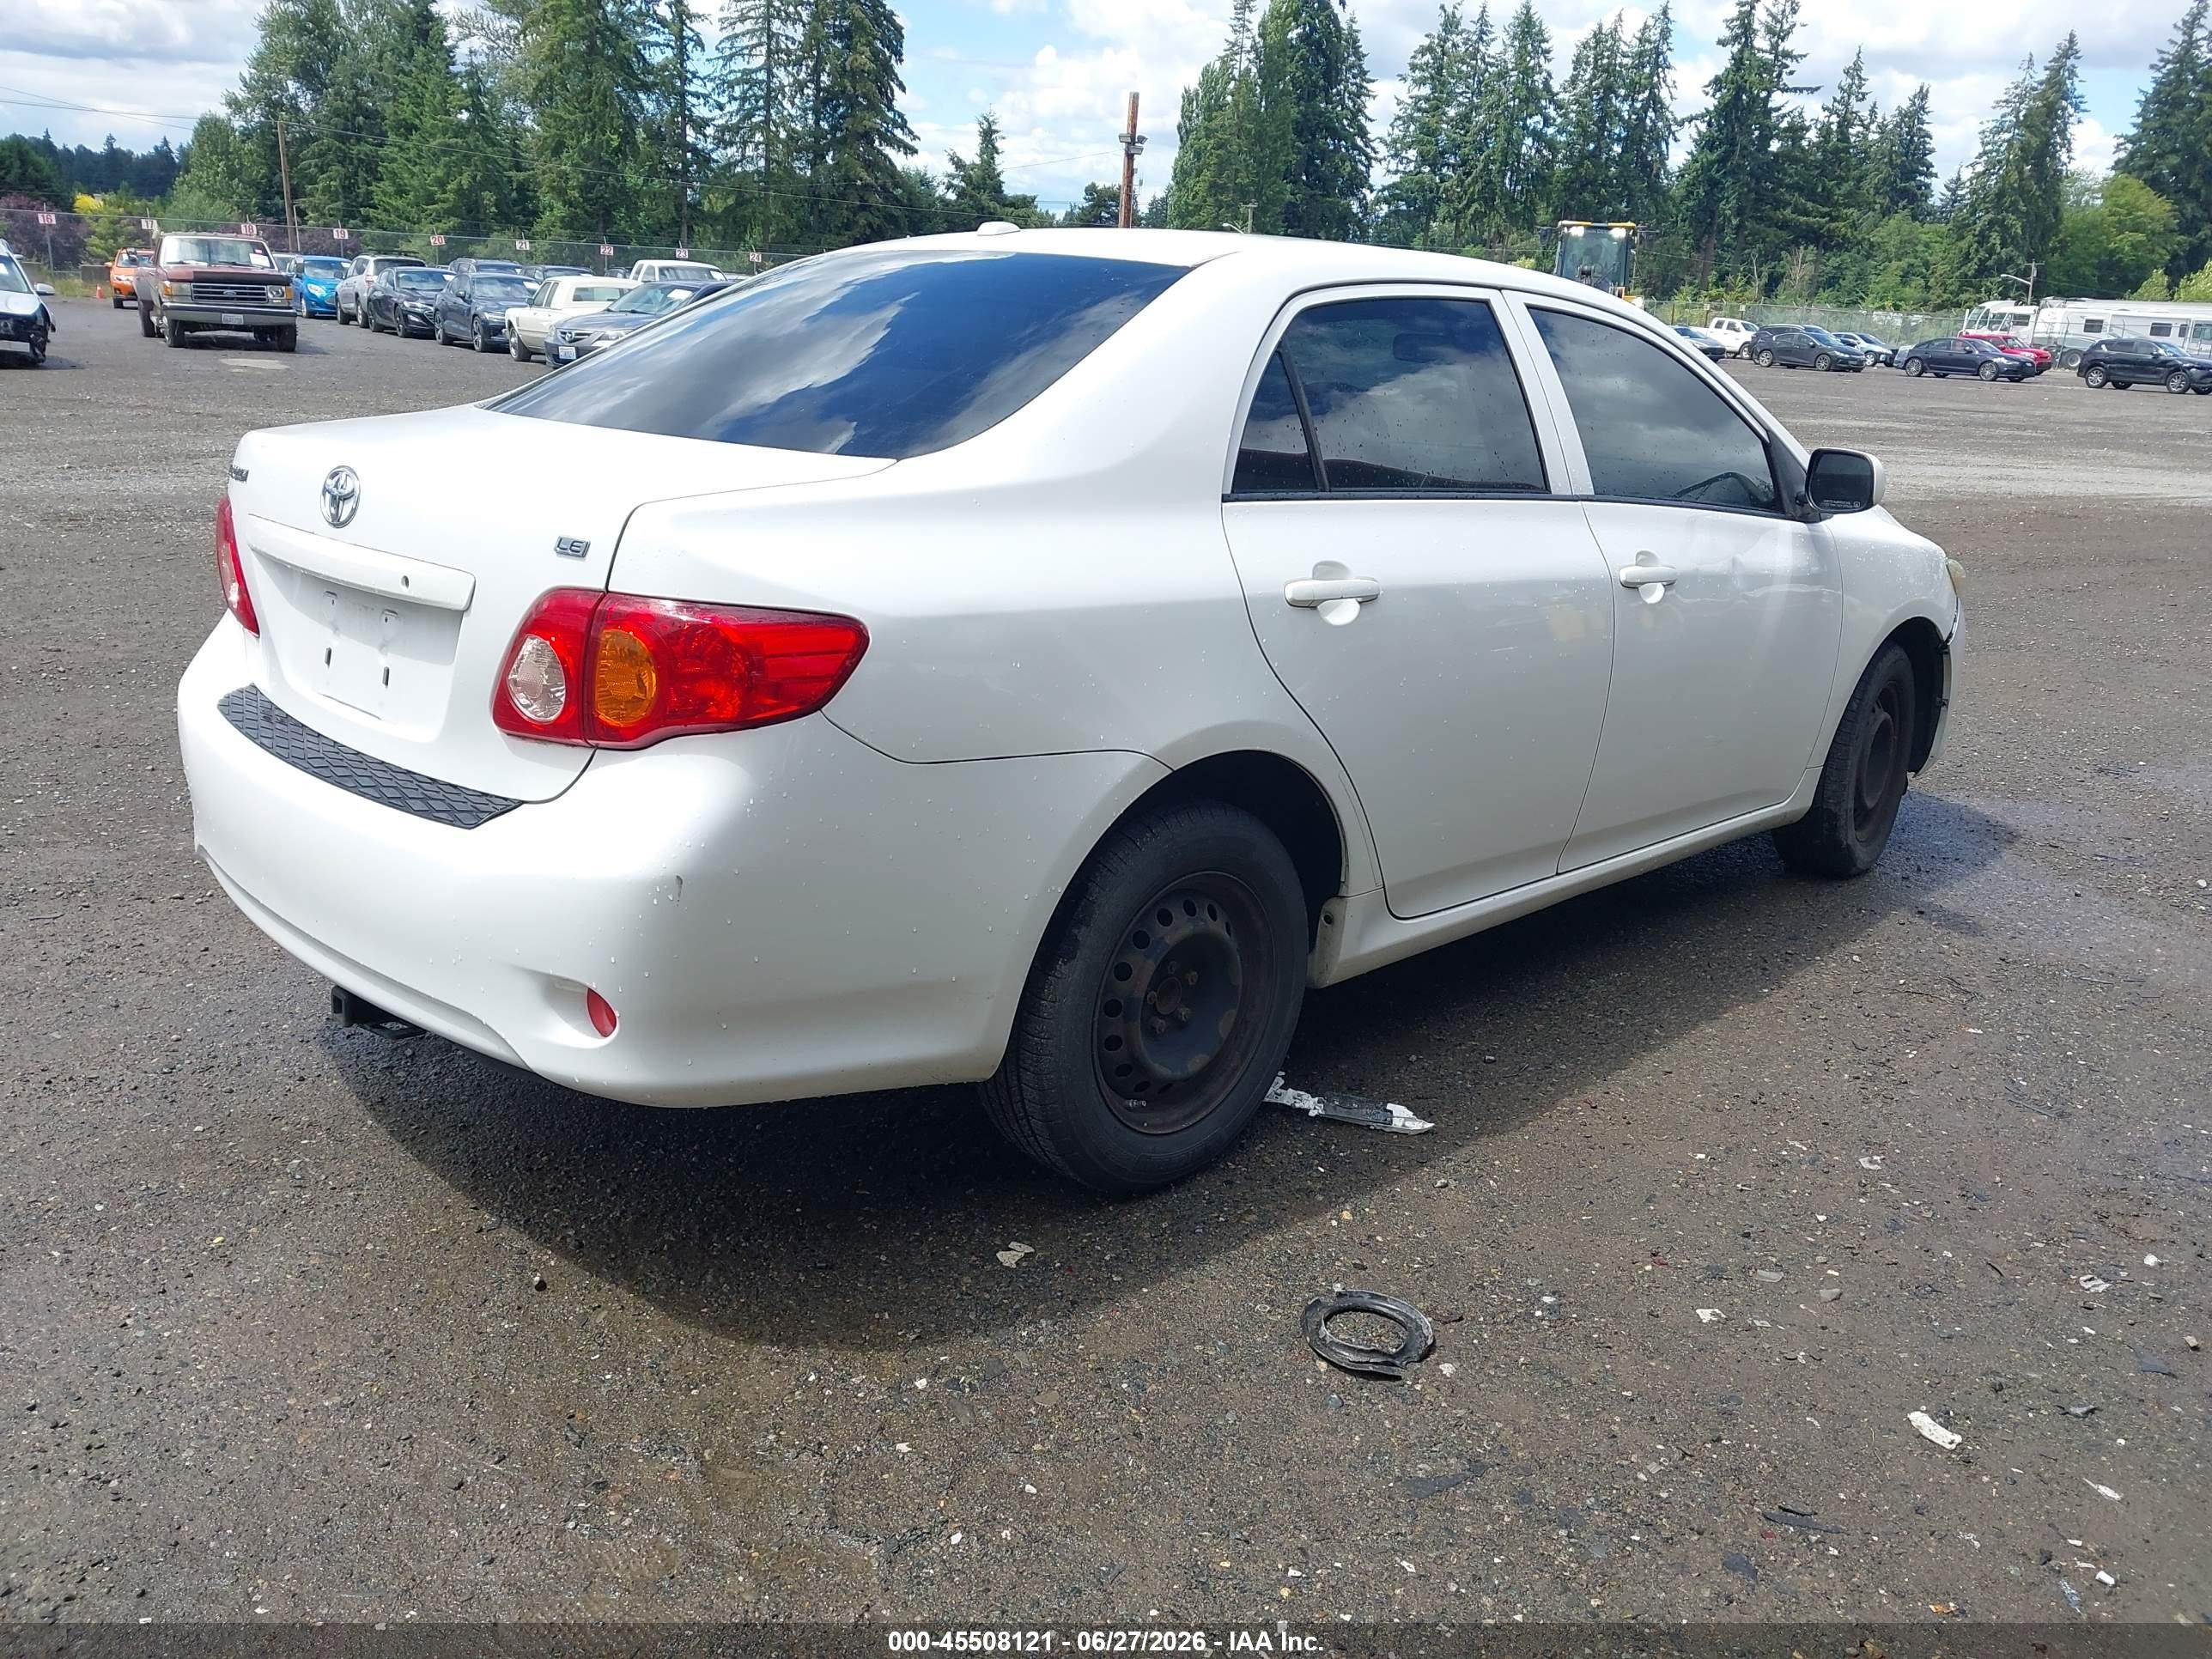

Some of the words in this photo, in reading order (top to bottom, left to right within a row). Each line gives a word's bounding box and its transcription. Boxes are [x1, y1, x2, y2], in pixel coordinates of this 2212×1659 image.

[40, 214, 52, 223] 16
[243, 225, 254, 234] 18
[335, 229, 345, 239] 19
[431, 236, 443, 245] 20
[750, 253, 761, 262] 24
[557, 538, 585, 553] LE
